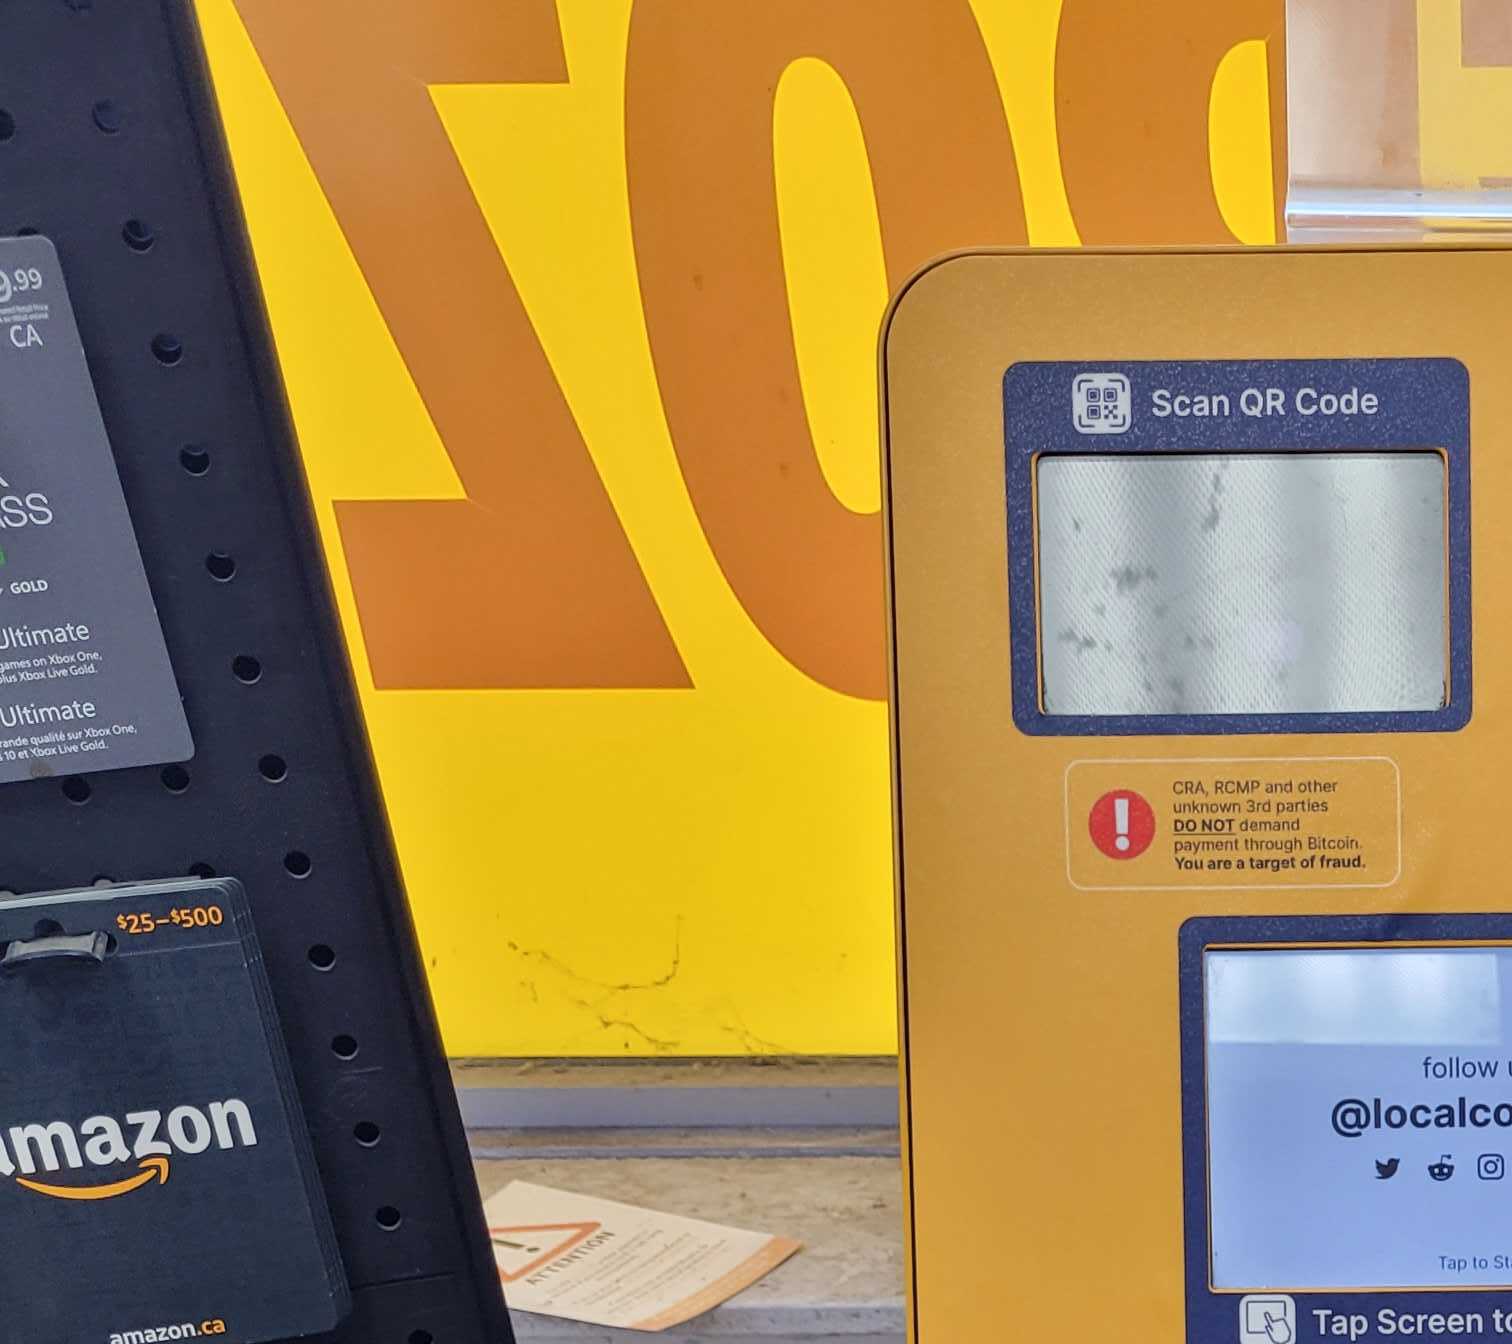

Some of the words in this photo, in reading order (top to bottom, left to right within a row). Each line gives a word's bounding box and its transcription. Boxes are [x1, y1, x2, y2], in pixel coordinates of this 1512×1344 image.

[9, 324, 44, 348] CA
[1151, 388, 1230, 418] Scan
[1239, 388, 1285, 418] QR
[1295, 387, 1380, 416] Code
[10, 579, 48, 595] GOLD
[33, 656, 47, 668] on
[48, 652, 76, 667] Xbox
[78, 650, 103, 664] One,
[18, 668, 47, 684] Xbox
[48, 666, 68, 680] Live
[70, 663, 98, 678] Gold.
[1, 699, 97, 728] Ultimate
[30, 729, 66, 747] qualité
[67, 729, 83, 741] sur
[83, 725, 112, 740] Xbox
[113, 722, 138, 737] One,
[30, 743, 57, 758] Xbox
[58, 741, 80, 755] Live
[80, 738, 109, 753] Gold.
[1172, 780, 1210, 797] CRA,
[1214, 780, 1261, 795] RCMP
[1264, 780, 1294, 794] and
[1297, 779, 1338, 793] other
[1173, 800, 1241, 814] unknown
[1246, 799, 1272, 814] 3rd
[1276, 798, 1329, 816] parties
[1174, 819, 1198, 833] DO
[1201, 818, 1237, 833] NOT
[1239, 817, 1301, 832] demand
[1174, 837, 1240, 854] payment
[1244, 836, 1303, 853] through
[1307, 834, 1363, 850] Bitcoin.
[1174, 856, 1203, 871] You
[1207, 858, 1233, 871] are
[1236, 859, 1246, 870] a
[1249, 855, 1296, 871] target
[1300, 855, 1317, 870] of
[1319, 854, 1367, 870] fraud.
[1422, 1056, 1498, 1080] follow
[525, 1230, 616, 1287] ATTENTION
[1438, 1254, 1468, 1274] Tap
[1472, 1254, 1489, 1271] to
[1312, 1309, 1369, 1342] Tap
[1376, 1307, 1485, 1336] Screen
